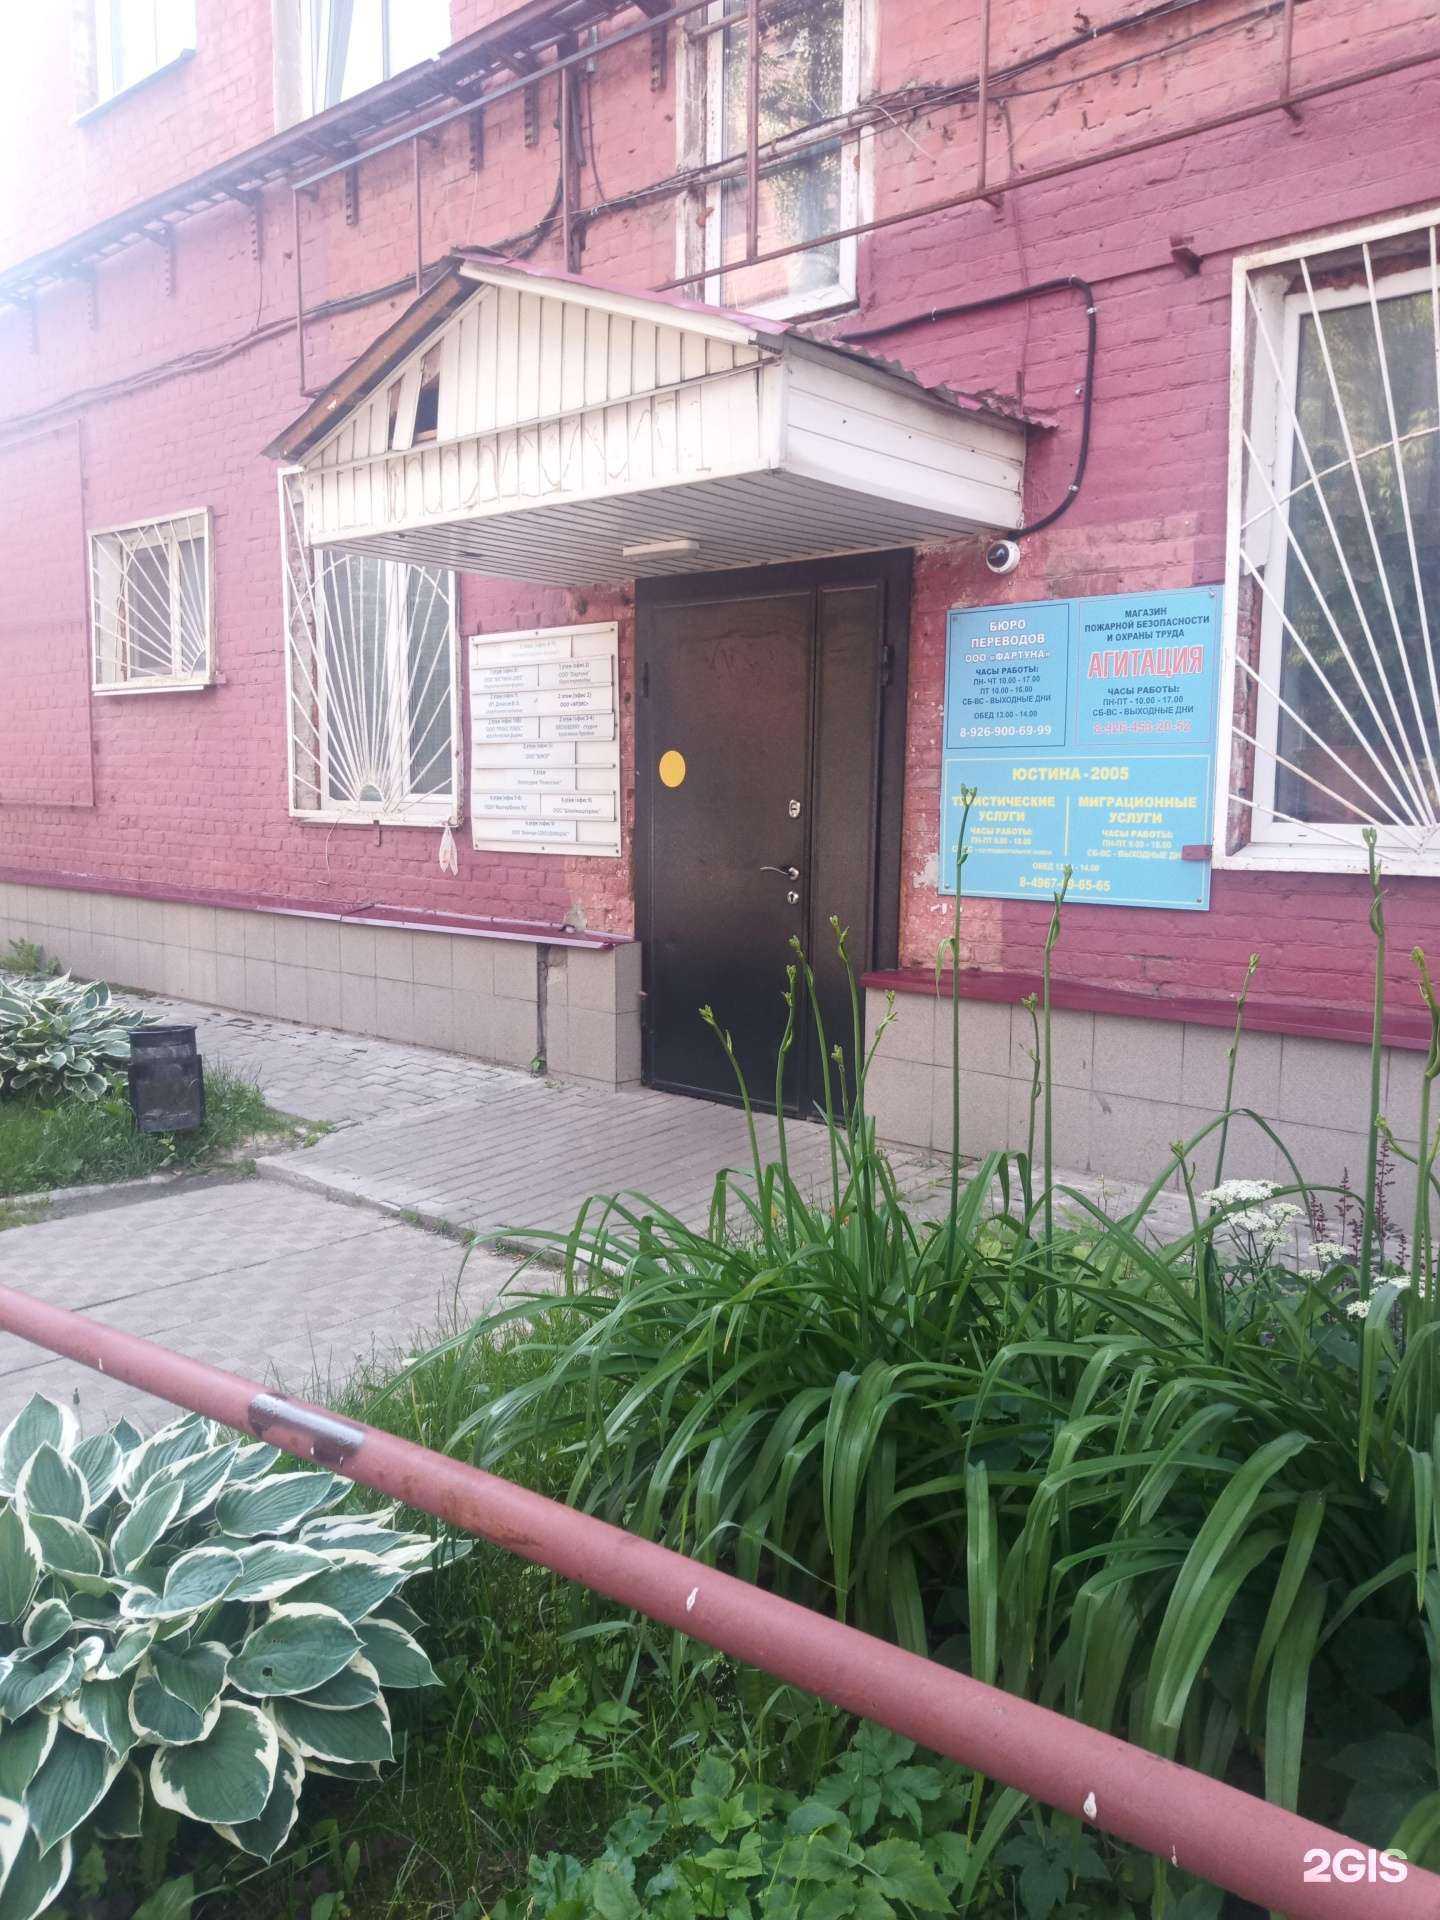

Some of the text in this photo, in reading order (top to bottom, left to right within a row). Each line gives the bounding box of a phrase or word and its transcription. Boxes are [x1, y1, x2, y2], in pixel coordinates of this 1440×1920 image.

[1124, 607, 1168, 618] МАГАЗИН
[989, 620, 1026, 632] БЮРО
[1084, 615, 1210, 633] ПОЖАРНОЙ БЕЗОПАСНОСТИ
[971, 633, 1046, 648] ПЕРЕВОДОВ
[1106, 629, 1185, 642] И ОХРАНЫ ТРУДА
[965, 650, 1050, 663] ООО «ФАРТУНА»
[1088, 644, 1205, 680] АГИТАЦИЯ
[976, 666, 1039, 676] ЧАСЫ РАБОТЫ:
[999, 676, 1016, 684] 10.00
[980, 687, 990, 695] ПТ
[1107, 685, 1180, 696] ЧАСЫ РАБОТЫ:
[990, 696, 1033, 705] ВЫХОДНЫЕ
[1034, 695, 1052, 703] ДНИ
[1103, 698, 1128, 706] ПН-ПТ
[1135, 696, 1156, 705] 10.00
[974, 711, 994, 720] ОБЕД
[1092, 708, 1118, 717] СБ-ВС
[1124, 706, 1174, 717] ВЫХОДНЫЕ
[1175, 705, 1194, 715] ДНИ
[1012, 767, 1081, 781] ЮСТИНА
[1090, 766, 1130, 781] 2005
[1078, 795, 1198, 809] МИГРАЦИОННЫЕ
[979, 811, 1026, 822] УСЛУГИ
[1109, 812, 1164, 824] УСЛУГИ
